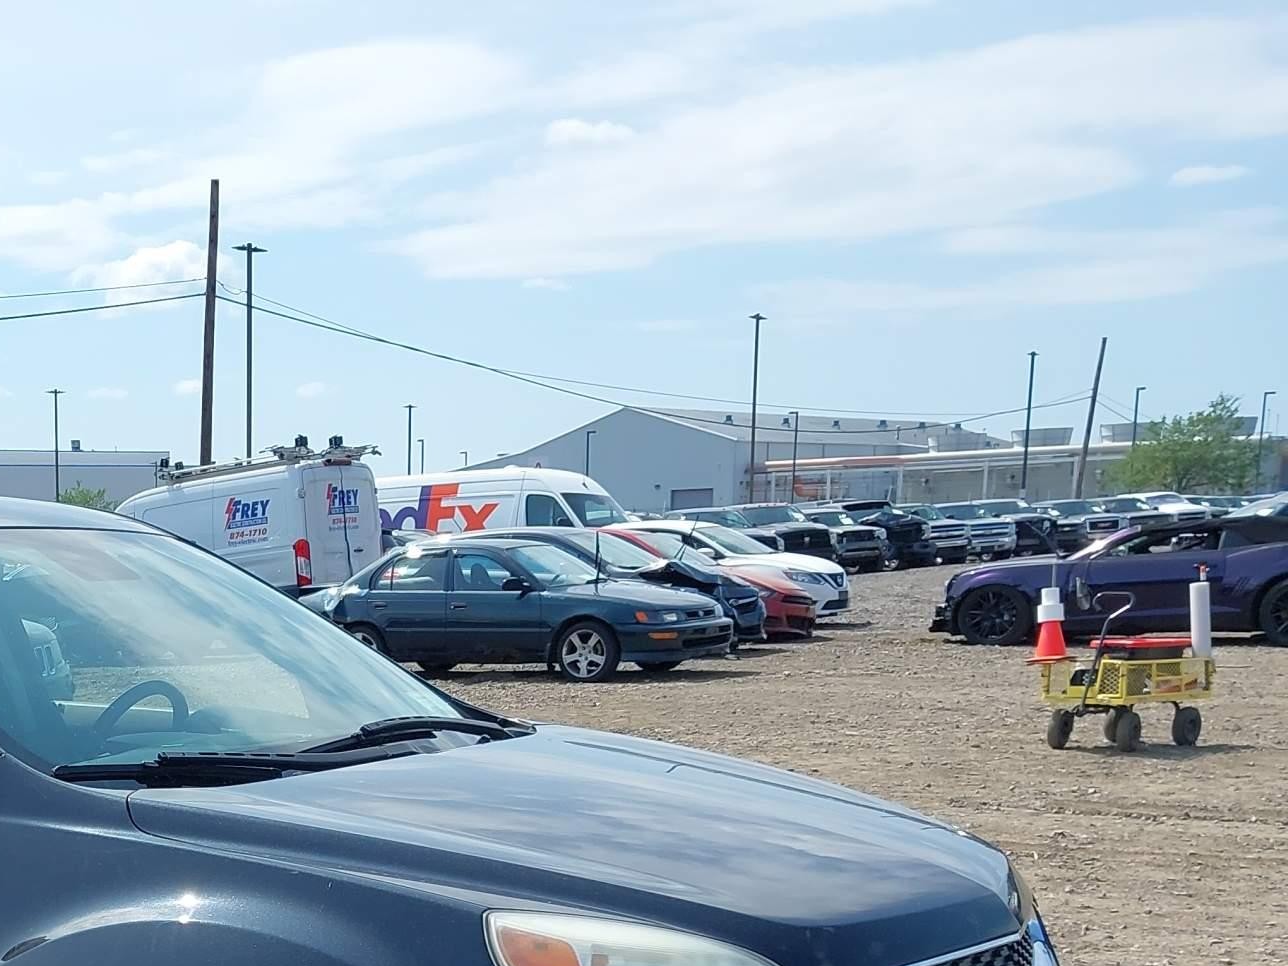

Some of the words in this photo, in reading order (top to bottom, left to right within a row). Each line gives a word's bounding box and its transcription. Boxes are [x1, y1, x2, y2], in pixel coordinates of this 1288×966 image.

[332, 486, 359, 506] FREY
[231, 499, 270, 520] FREY
[229, 528, 268, 540] 874-1710
